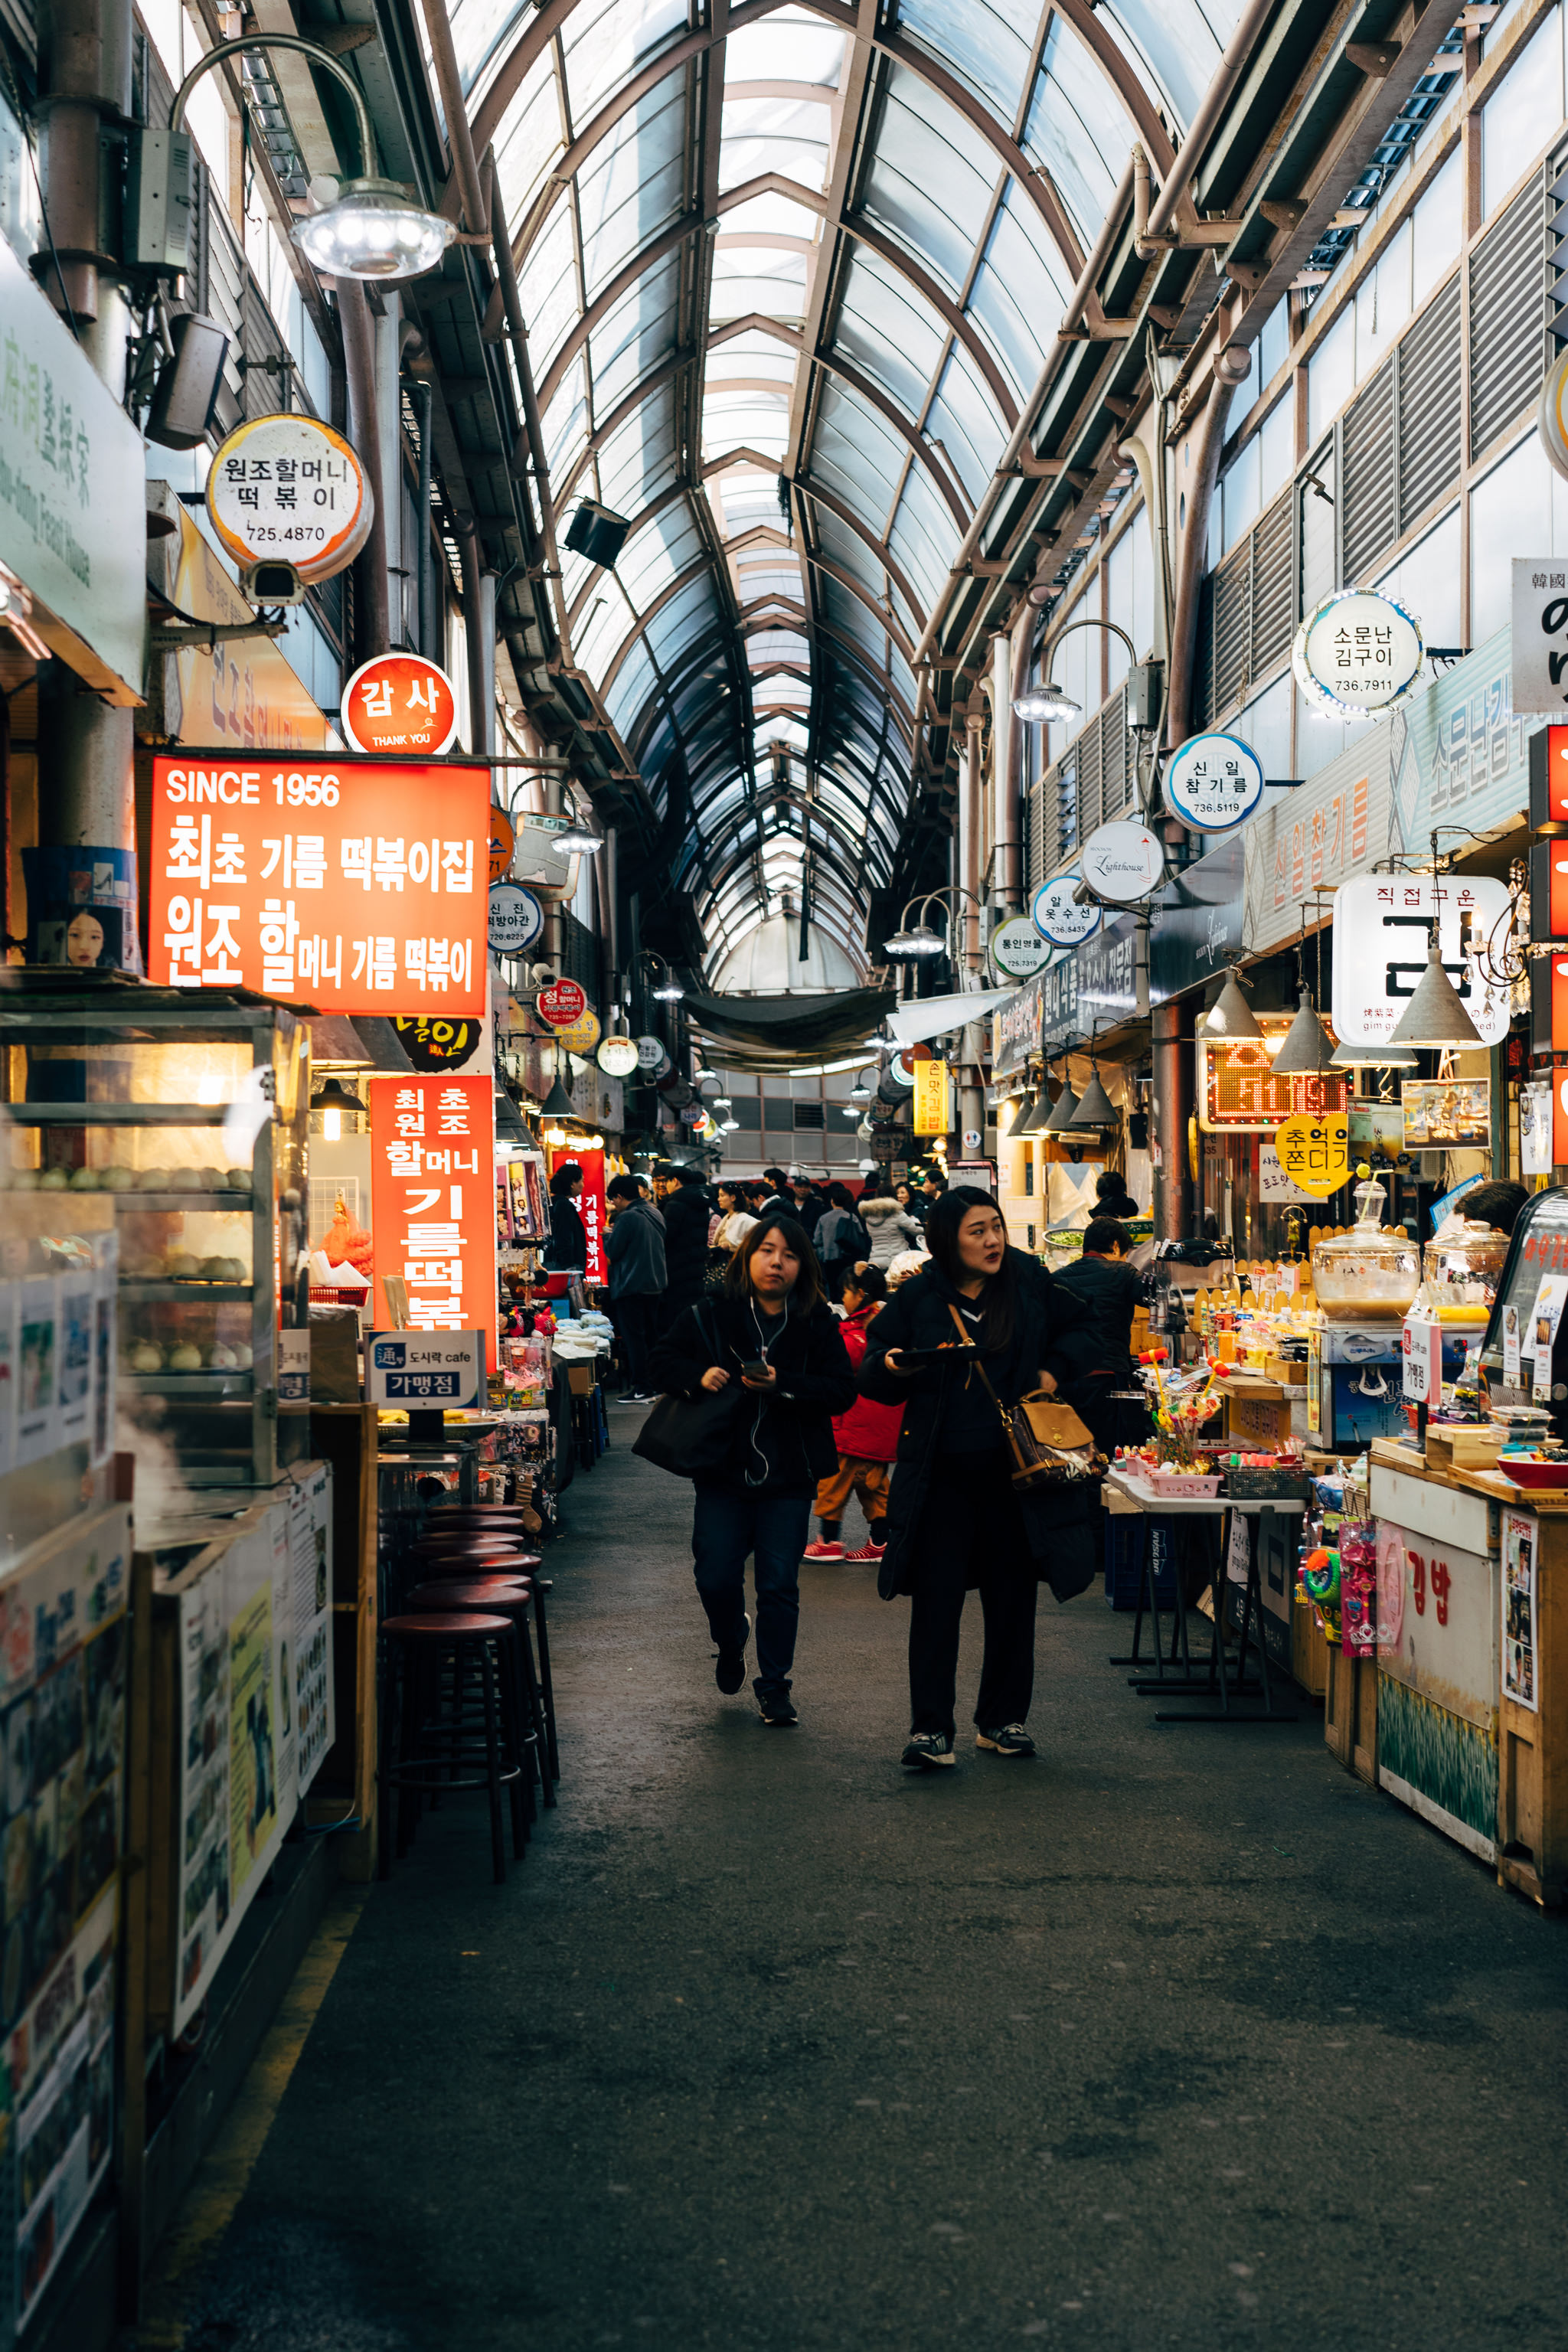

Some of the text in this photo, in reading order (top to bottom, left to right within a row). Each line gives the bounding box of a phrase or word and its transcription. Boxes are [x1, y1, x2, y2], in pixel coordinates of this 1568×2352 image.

[224, 459, 347, 483] 원조할머니
[237, 486, 335, 511] 떡볶이
[247, 527, 325, 542] 725.4870
[1531, 573, 1568, 589] 韓國
[1334, 626, 1393, 645] 소문난
[1334, 648, 1393, 668] 김구이
[1334, 681, 1393, 692] 736.7911
[361, 678, 440, 717] 감사
[372, 733, 430, 747] THANK YOU
[1193, 760, 1240, 776] 신일
[166, 769, 340, 807] SINCE 1956
[1185, 778, 1248, 795] 참기름
[1193, 802, 1240, 813] 736.5119
[165, 814, 247, 890] 최초
[260, 834, 328, 889] 기름
[340, 836, 474, 893] 떡볶이집
[1093, 854, 1145, 876] Lighthouse
[1045, 908, 1090, 920] 옷수선
[1050, 926, 1086, 934] 736.5435
[164, 895, 473, 994] 원조 할머니 기름 떡볶이
[1001, 939, 1043, 950] 통인명물
[544, 990, 558, 1004] 정
[559, 995, 581, 1004] 할머니
[1363, 1022, 1383, 1031] gim
[394, 1088, 471, 1112] 최초
[394, 1114, 471, 1137] 원조
[385, 1139, 479, 1178] 할머니
[1263, 1155, 1280, 1168] 시원
[410, 1351, 471, 1364] 도시락 cafe
[391, 1375, 453, 1396] 가맹점
[1407, 1550, 1451, 1626] 김밥
